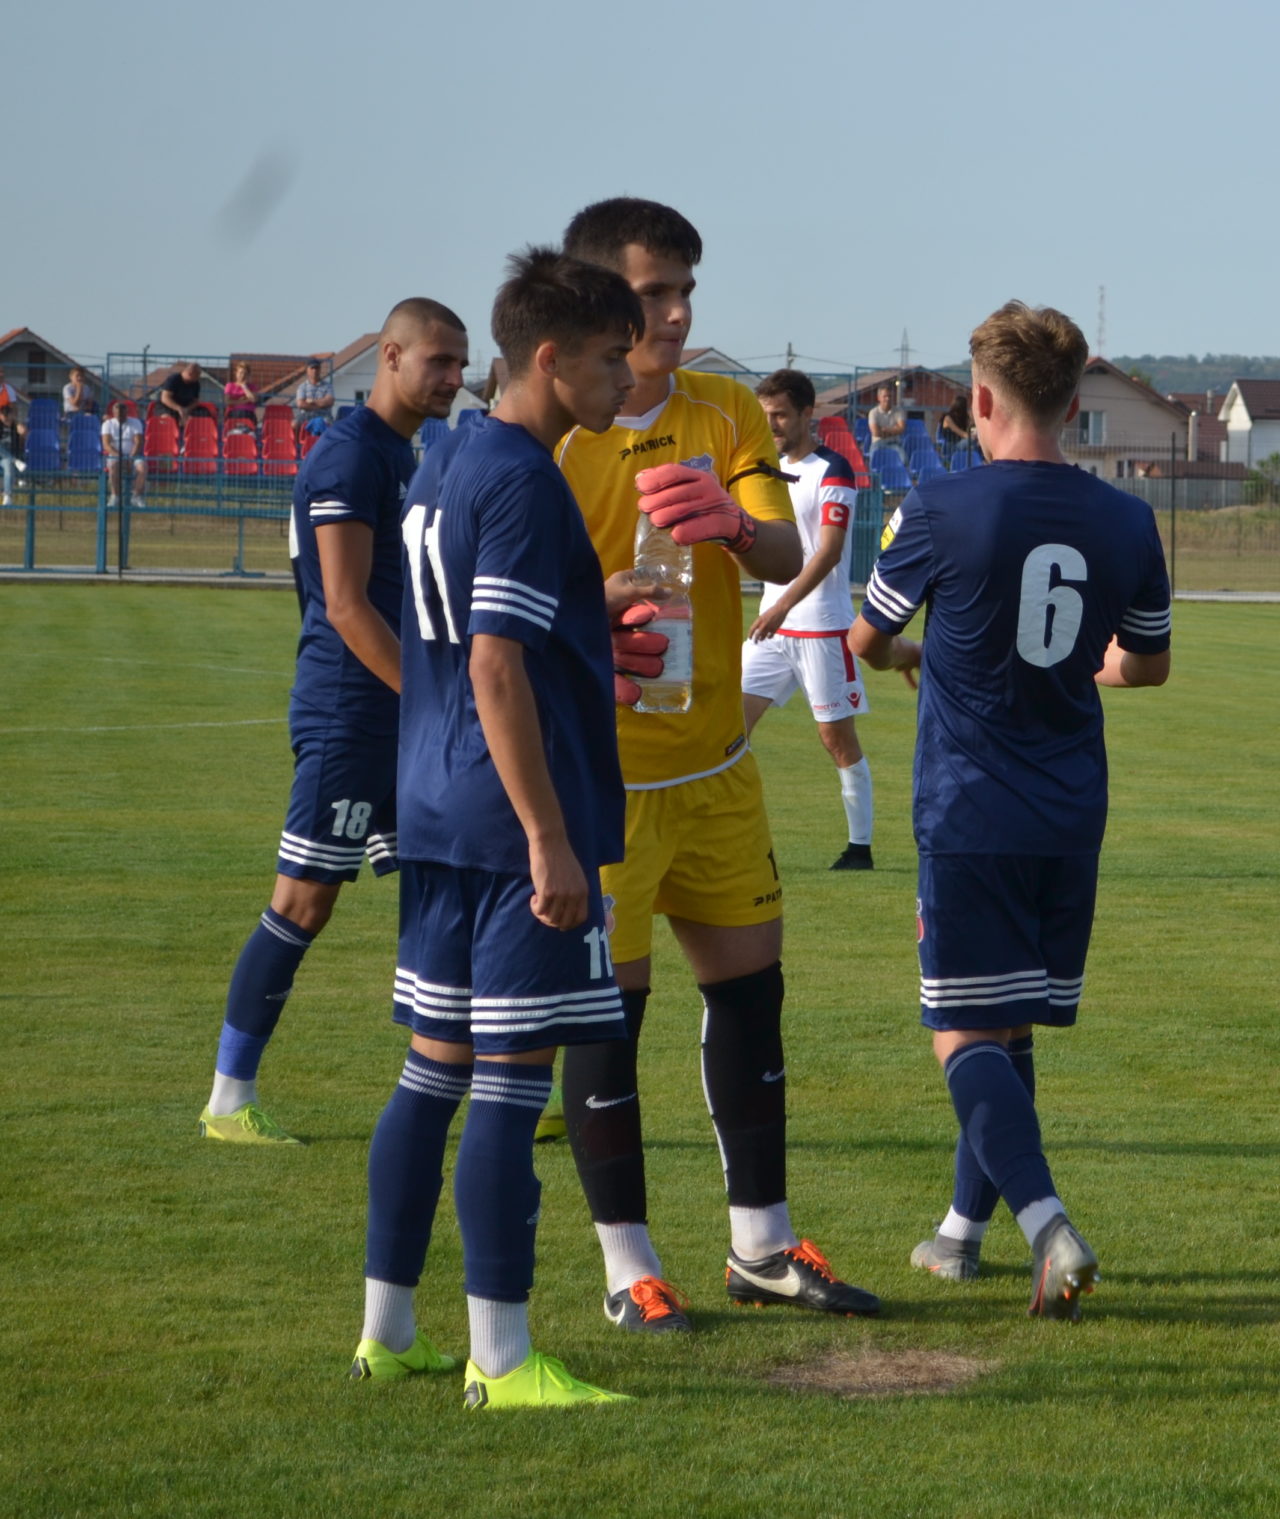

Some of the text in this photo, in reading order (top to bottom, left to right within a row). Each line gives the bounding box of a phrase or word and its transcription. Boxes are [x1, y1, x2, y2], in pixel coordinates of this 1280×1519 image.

[632, 434, 676, 455] PATRICK
[828, 506, 844, 522] C
[401, 504, 460, 643] 11
[1016, 544, 1088, 668] 6
[331, 798, 373, 839] 18
[583, 926, 614, 979] 11
